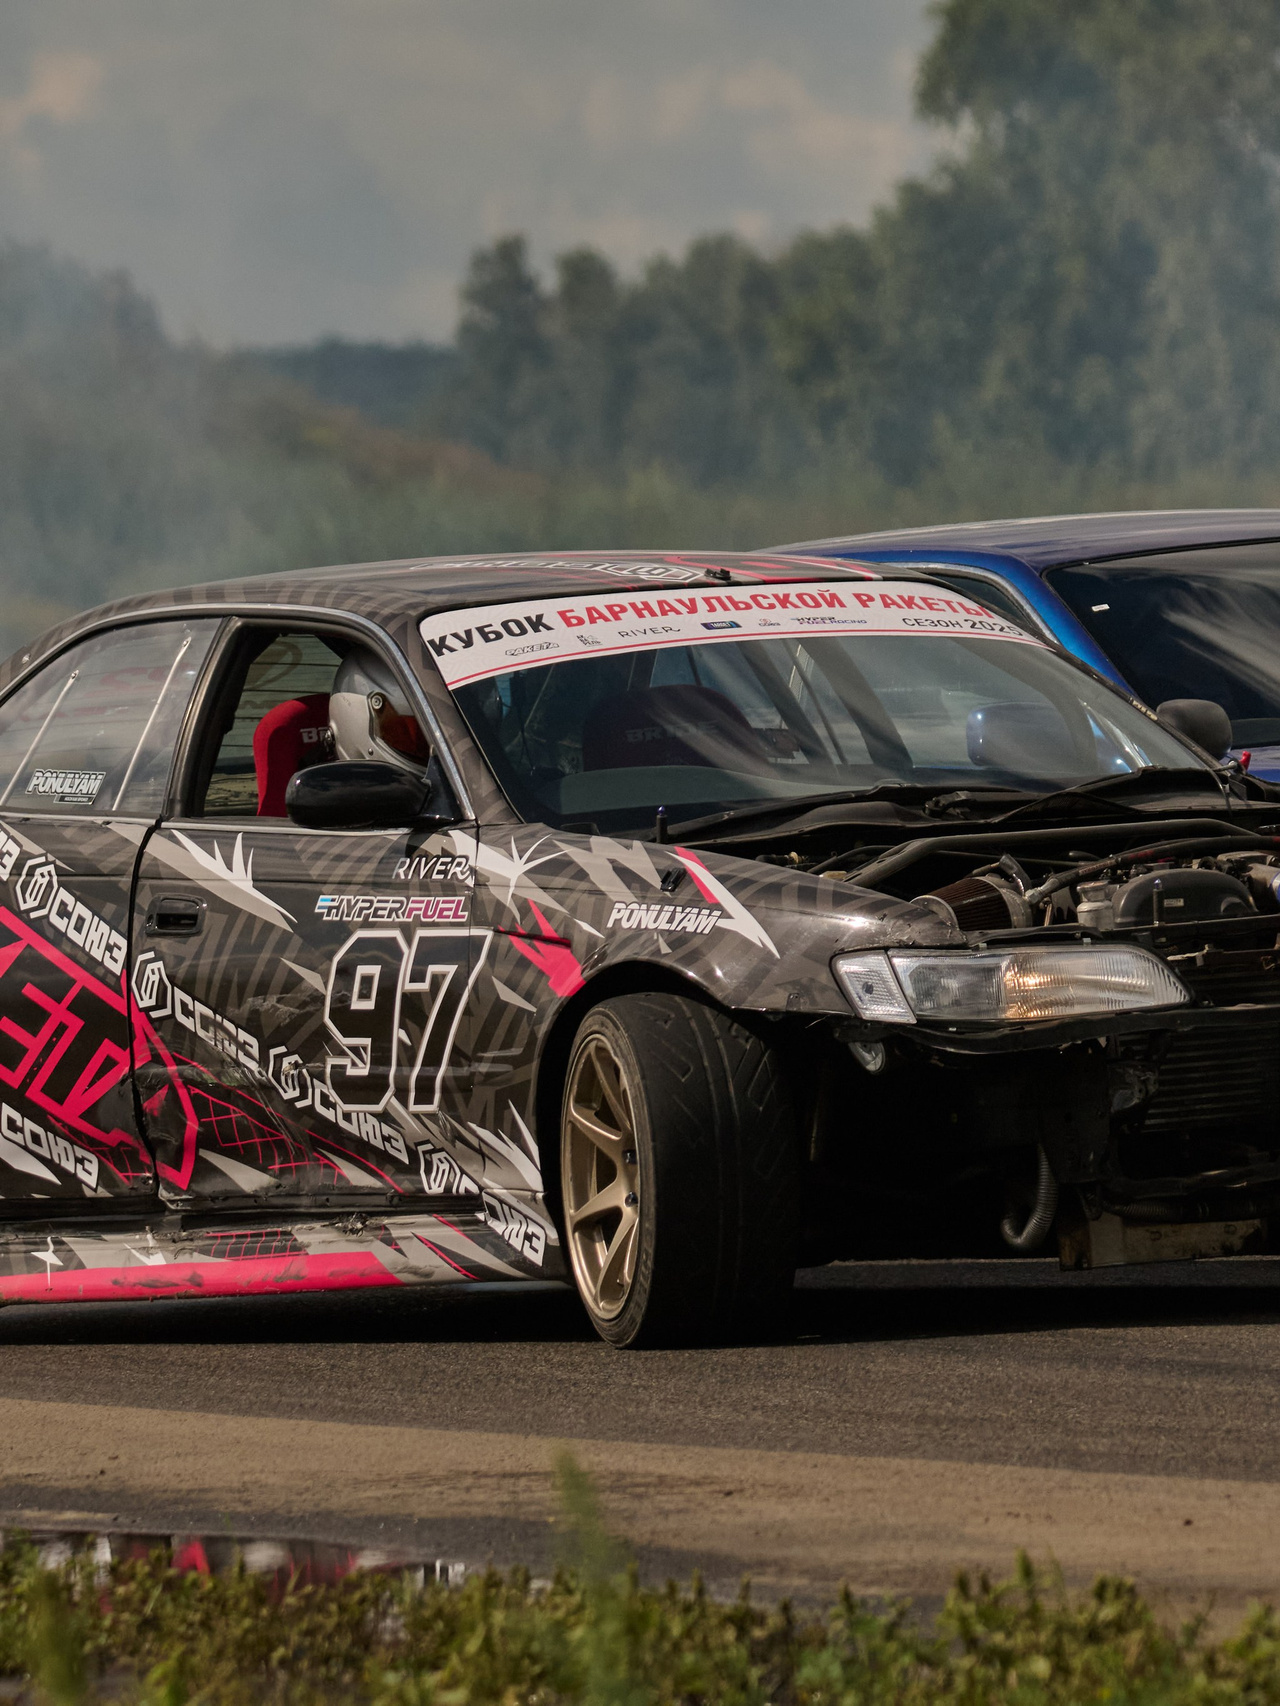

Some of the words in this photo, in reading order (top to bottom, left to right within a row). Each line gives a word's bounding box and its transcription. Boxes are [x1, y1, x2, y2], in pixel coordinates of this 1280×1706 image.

[427, 613, 555, 657] КУБОК
[557, 589, 847, 628] БАРНАУЛЬСКОЙ
[852, 592, 995, 619] РАКЕТЫ
[618, 626, 681, 638] RIVER
[902, 617, 963, 629] СЕЗОН
[963, 618, 1024, 637] 2025
[504, 641, 560, 657] РАКЕТА
[26, 769, 104, 795] PONULYAM
[392, 857, 473, 883] RIVER
[315, 895, 470, 922] HYPERFUEL
[606, 902, 723, 935] PONULYAM
[50, 887, 128, 976] СОЮЗ
[324, 929, 493, 1111] 97
[1, 1102, 99, 1189] СОЮЗ
